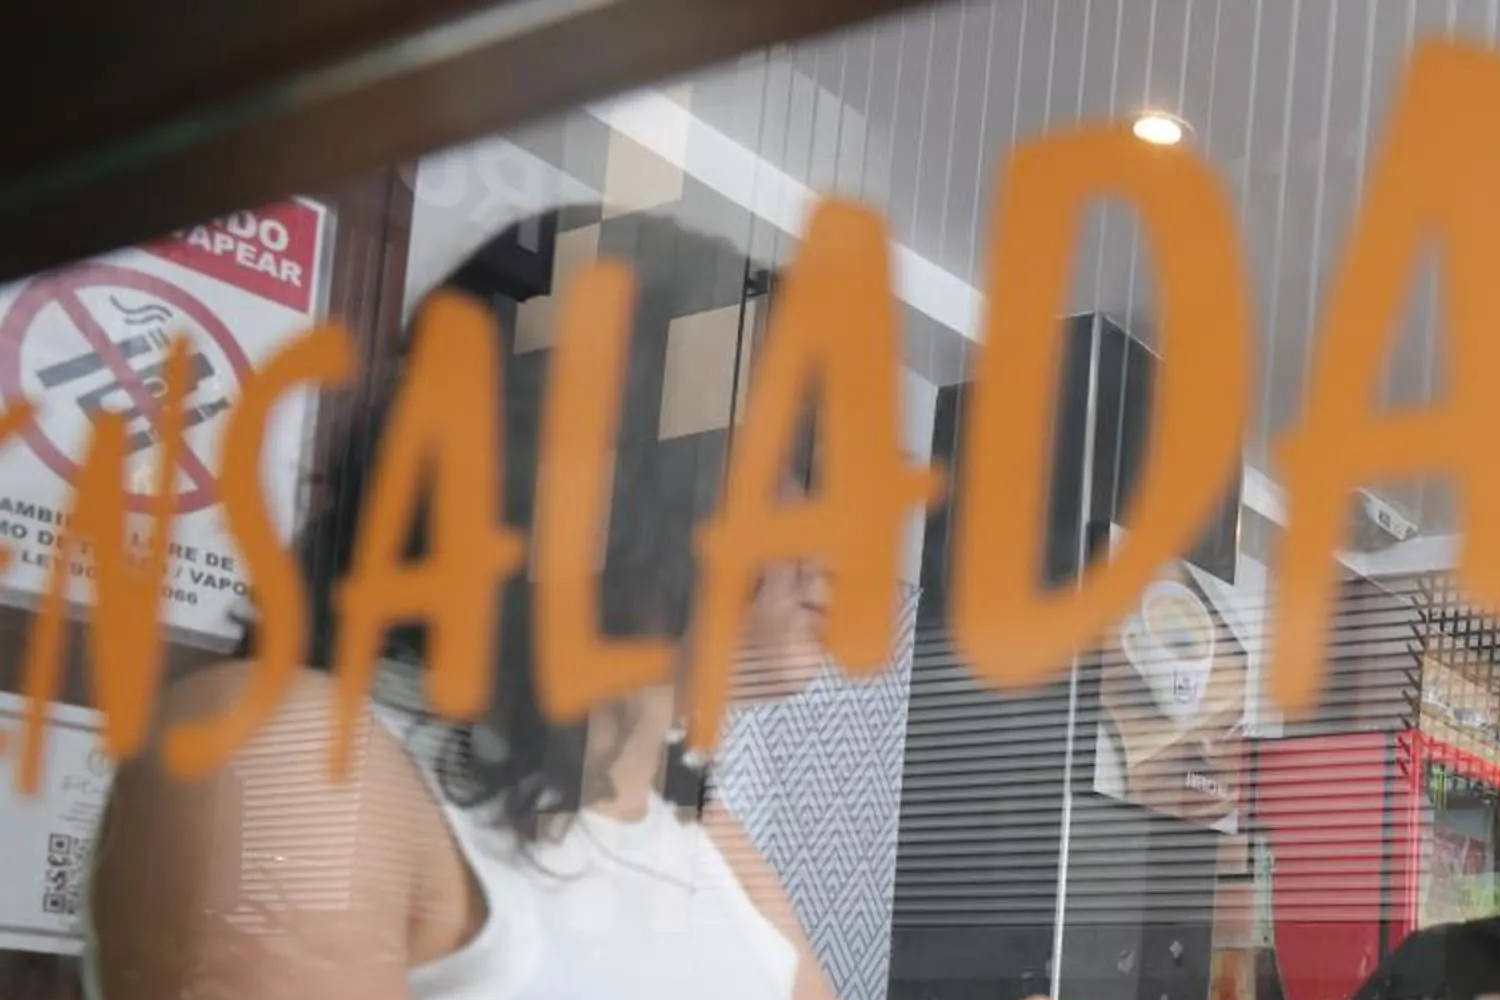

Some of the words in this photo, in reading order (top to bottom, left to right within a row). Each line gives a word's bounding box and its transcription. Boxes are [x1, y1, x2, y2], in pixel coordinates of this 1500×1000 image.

[226, 210, 289, 252] DO
[172, 225, 304, 289] APEAR
[204, 551, 235, 572] DE
[188, 567, 256, 602] VAPO
